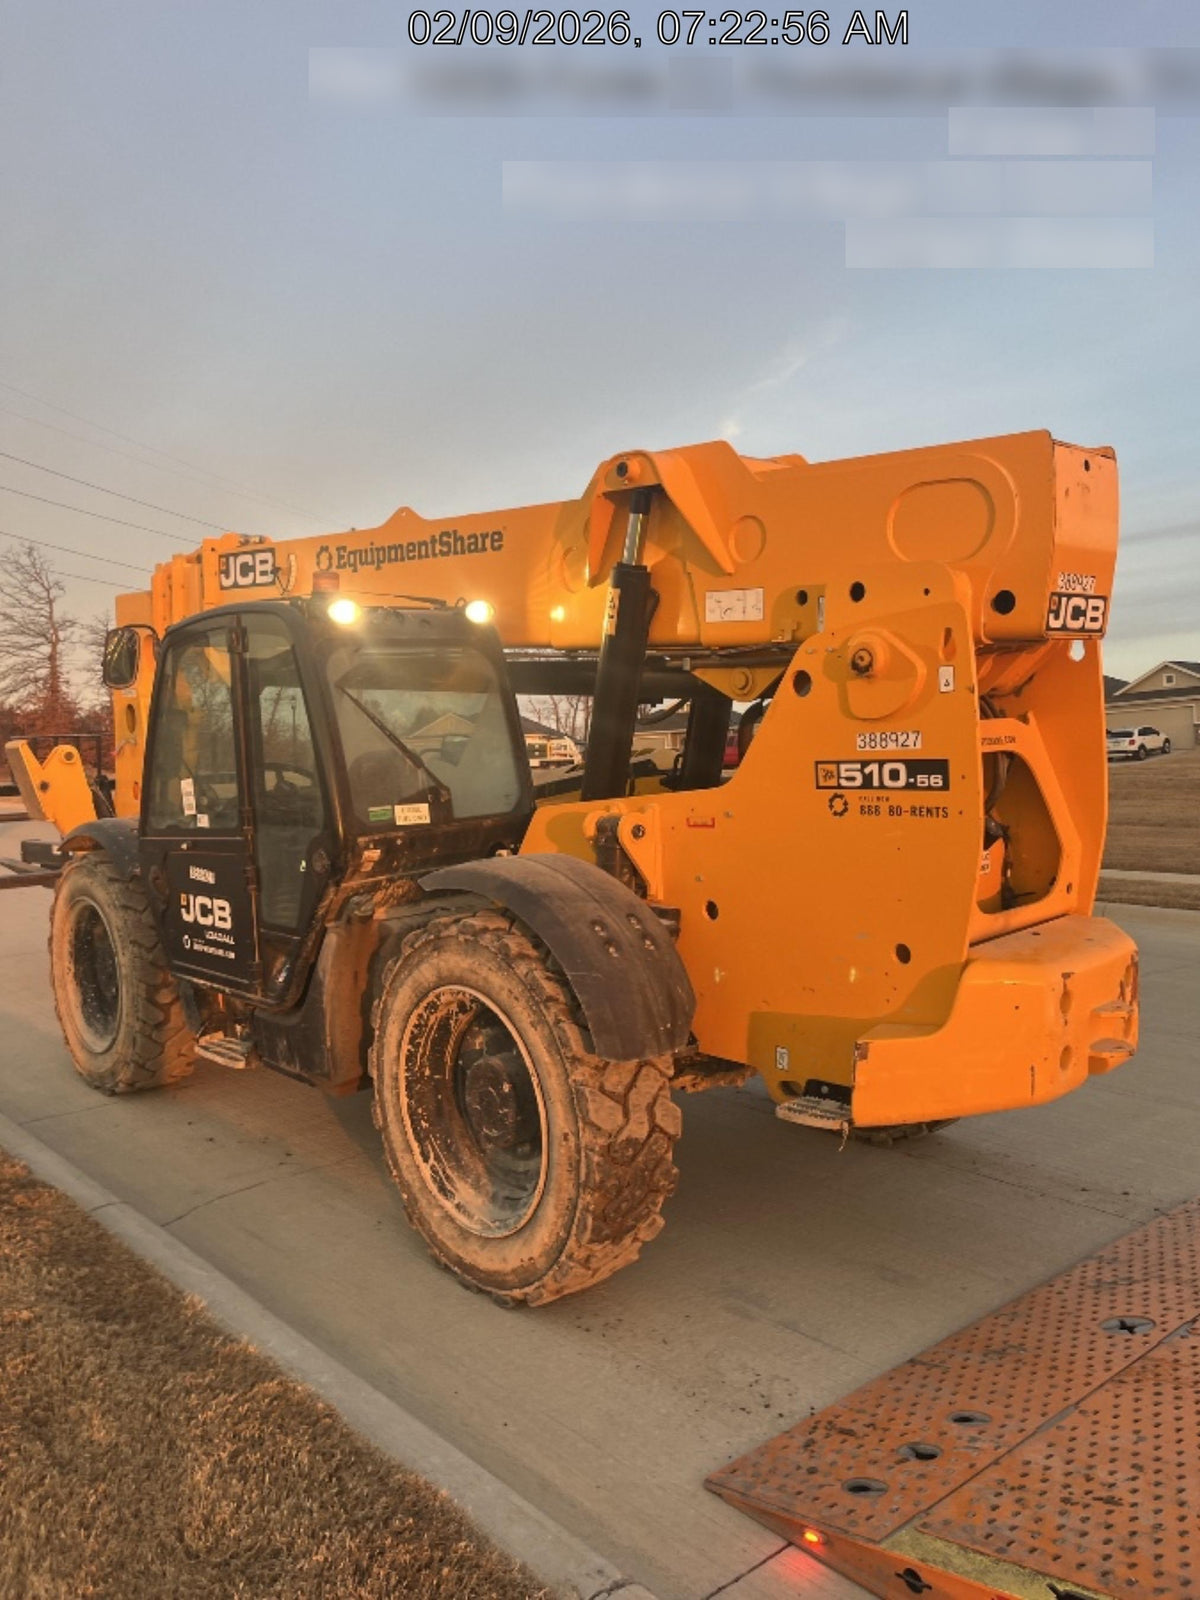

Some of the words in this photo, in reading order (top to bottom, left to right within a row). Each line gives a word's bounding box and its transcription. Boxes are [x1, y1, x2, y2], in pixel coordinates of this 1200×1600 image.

[335, 529, 504, 574] EquipmentShare
[219, 551, 276, 588] JCB
[1048, 596, 1105, 630] JCB
[858, 731, 920, 749] 388927
[838, 761, 943, 788] 510-56
[888, 805, 949, 819] 80-RENTS
[180, 893, 232, 930] JCB
